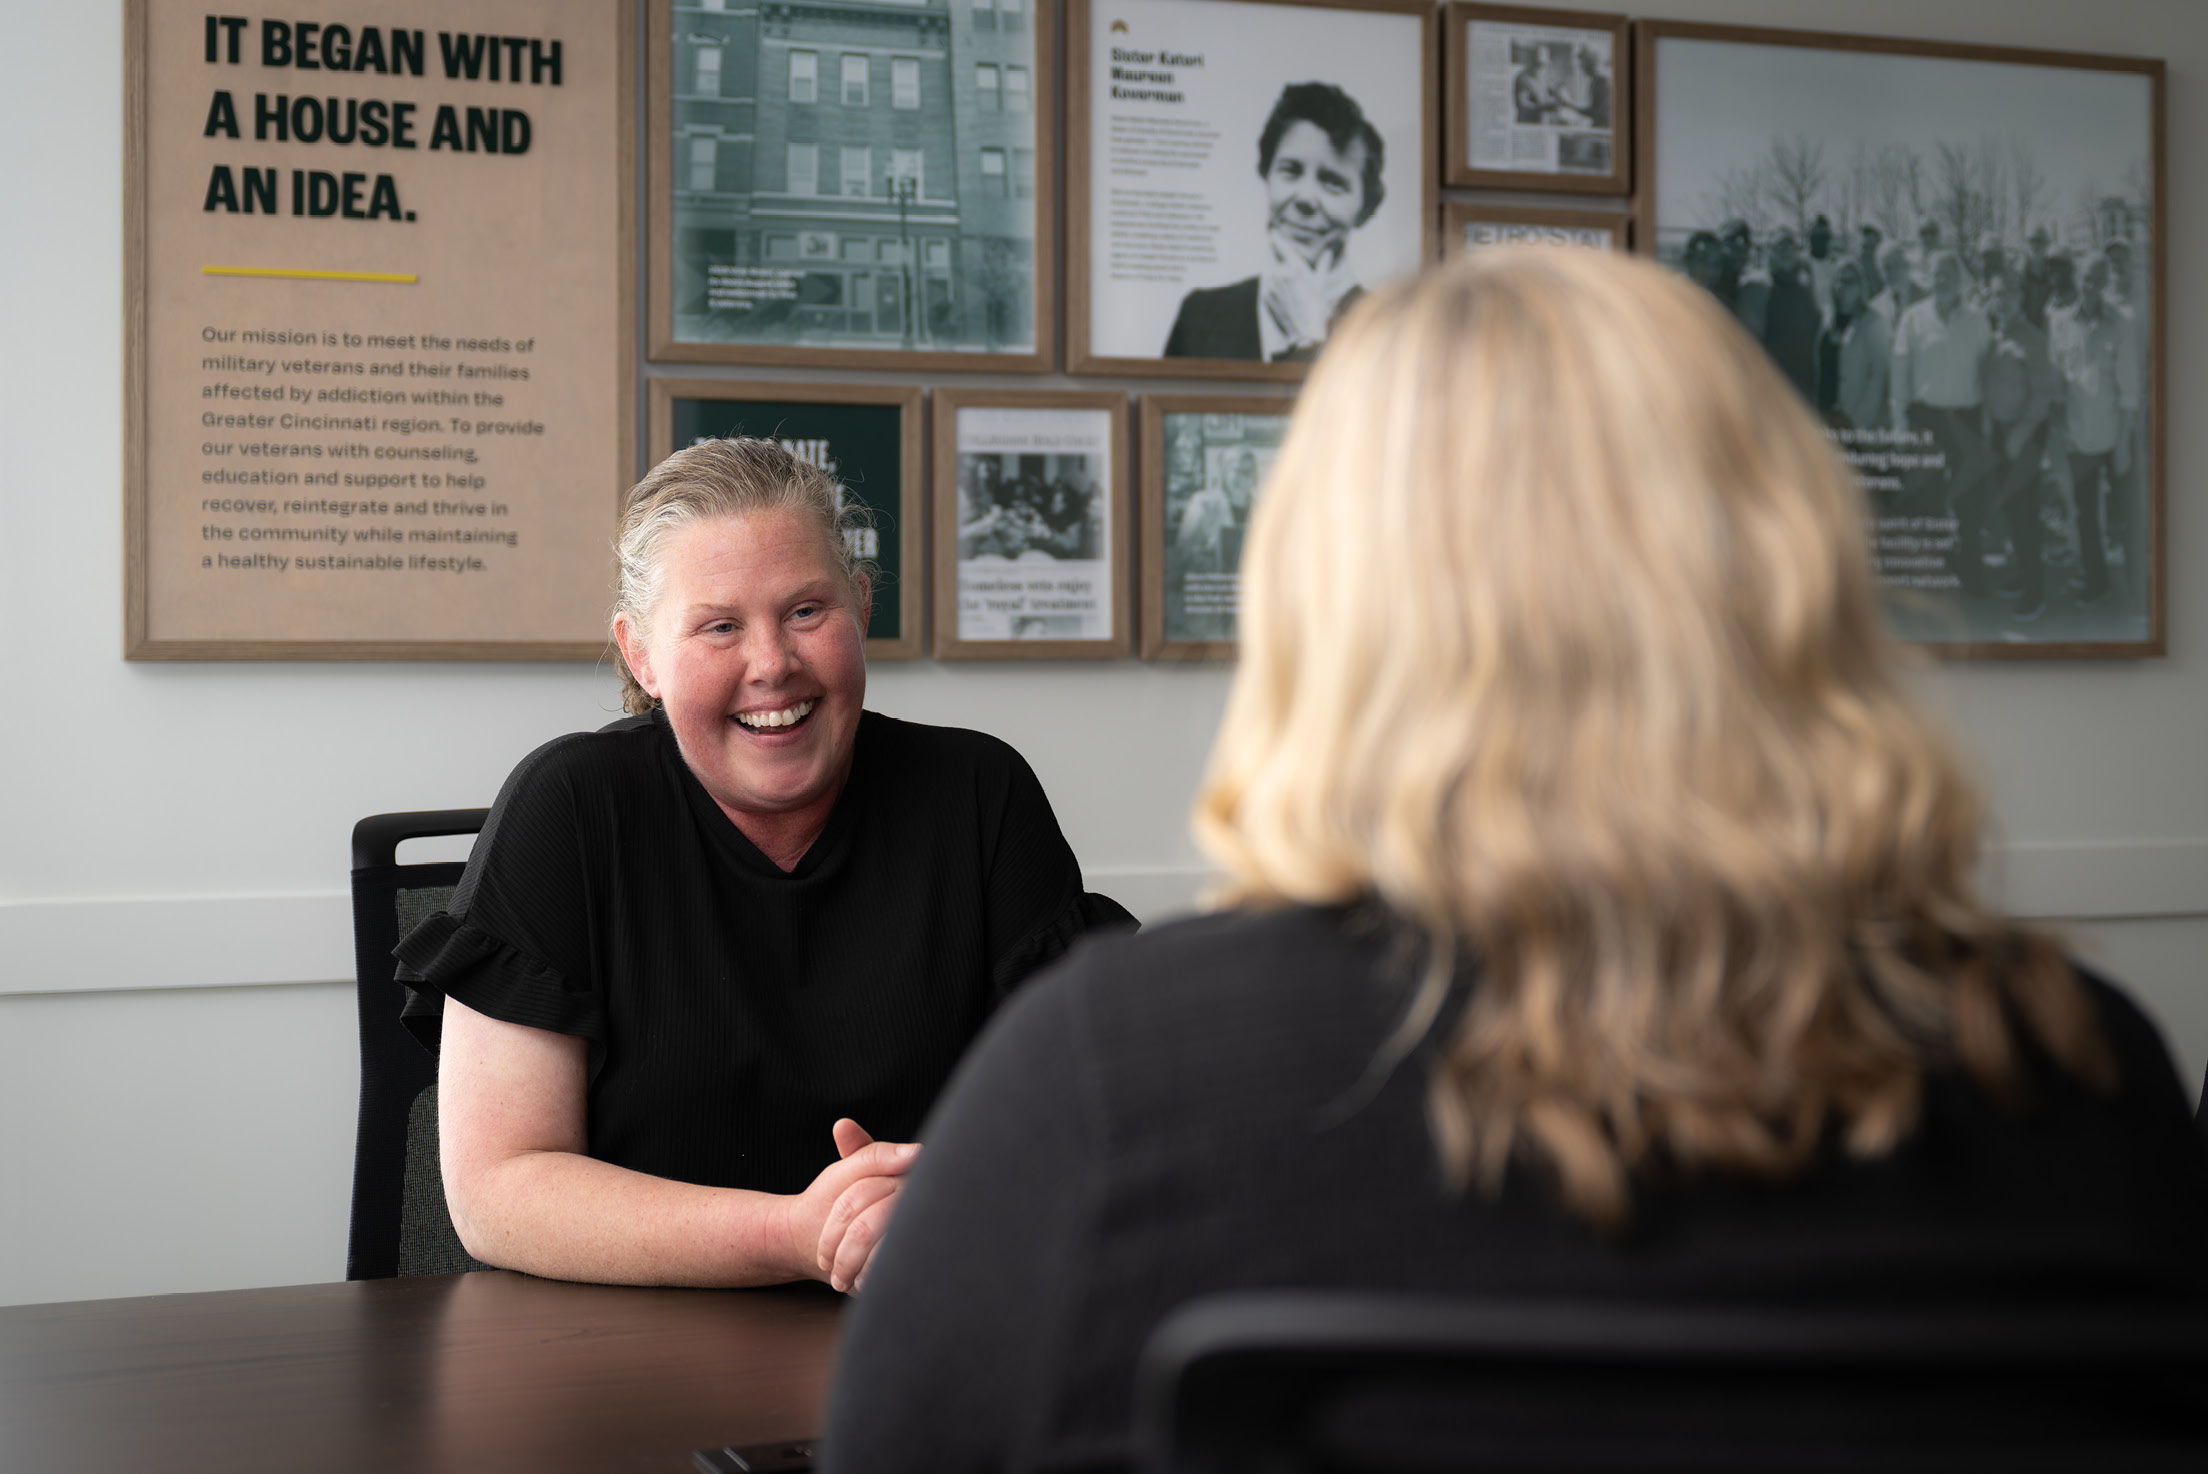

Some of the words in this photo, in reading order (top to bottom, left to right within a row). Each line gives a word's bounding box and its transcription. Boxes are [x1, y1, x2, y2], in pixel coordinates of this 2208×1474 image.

[204, 15, 248, 64] IT
[261, 18, 424, 77] BEGAN
[438, 32, 563, 86] WITH
[203, 90, 241, 139] A
[254, 93, 417, 149] HOUSE
[429, 104, 533, 155] AND
[203, 164, 277, 215] AN
[292, 169, 417, 222] IDEA.
[202, 326, 236, 342] Our
[242, 329, 316, 345] mission
[323, 330, 337, 346] is
[343, 332, 362, 347] to
[368, 334, 415, 349] meet
[421, 334, 451, 350] the
[456, 337, 511, 352] needs
[516, 338, 534, 353] of
[203, 354, 275, 375] military
[282, 359, 364, 375] veterans
[370, 361, 404, 376] and
[409, 361, 451, 377] their
[458, 361, 530, 380] families
[202, 382, 284, 400] affected
[290, 385, 312, 404] by
[318, 386, 406, 404] addiction
[411, 390, 469, 405] within
[474, 391, 503, 407] the
[202, 411, 274, 428] Greater
[280, 413, 376, 431] Cincinnati
[382, 418, 443, 435] region.
[451, 417, 471, 433] To
[476, 420, 544, 435] provide
[202, 442, 233, 455] our
[239, 441, 323, 458] veterans
[328, 443, 369, 458] with
[374, 445, 478, 464] counseling,
[202, 468, 298, 485] education
[304, 471, 338, 485] and
[344, 472, 416, 488] support
[422, 473, 441, 488] to
[446, 473, 485, 490] help
[202, 498, 277, 514] recover,
[284, 499, 388, 517] reintegrate
[394, 500, 427, 515] and
[433, 500, 486, 516] thrive
[492, 501, 508, 515] in
[202, 524, 233, 540] the
[239, 527, 348, 545] community
[354, 527, 403, 542] while
[409, 529, 517, 547] maintaining
[202, 555, 212, 568] a
[218, 552, 289, 572] healthy
[295, 554, 403, 570] sustainable
[409, 554, 485, 573] lifestyle.
